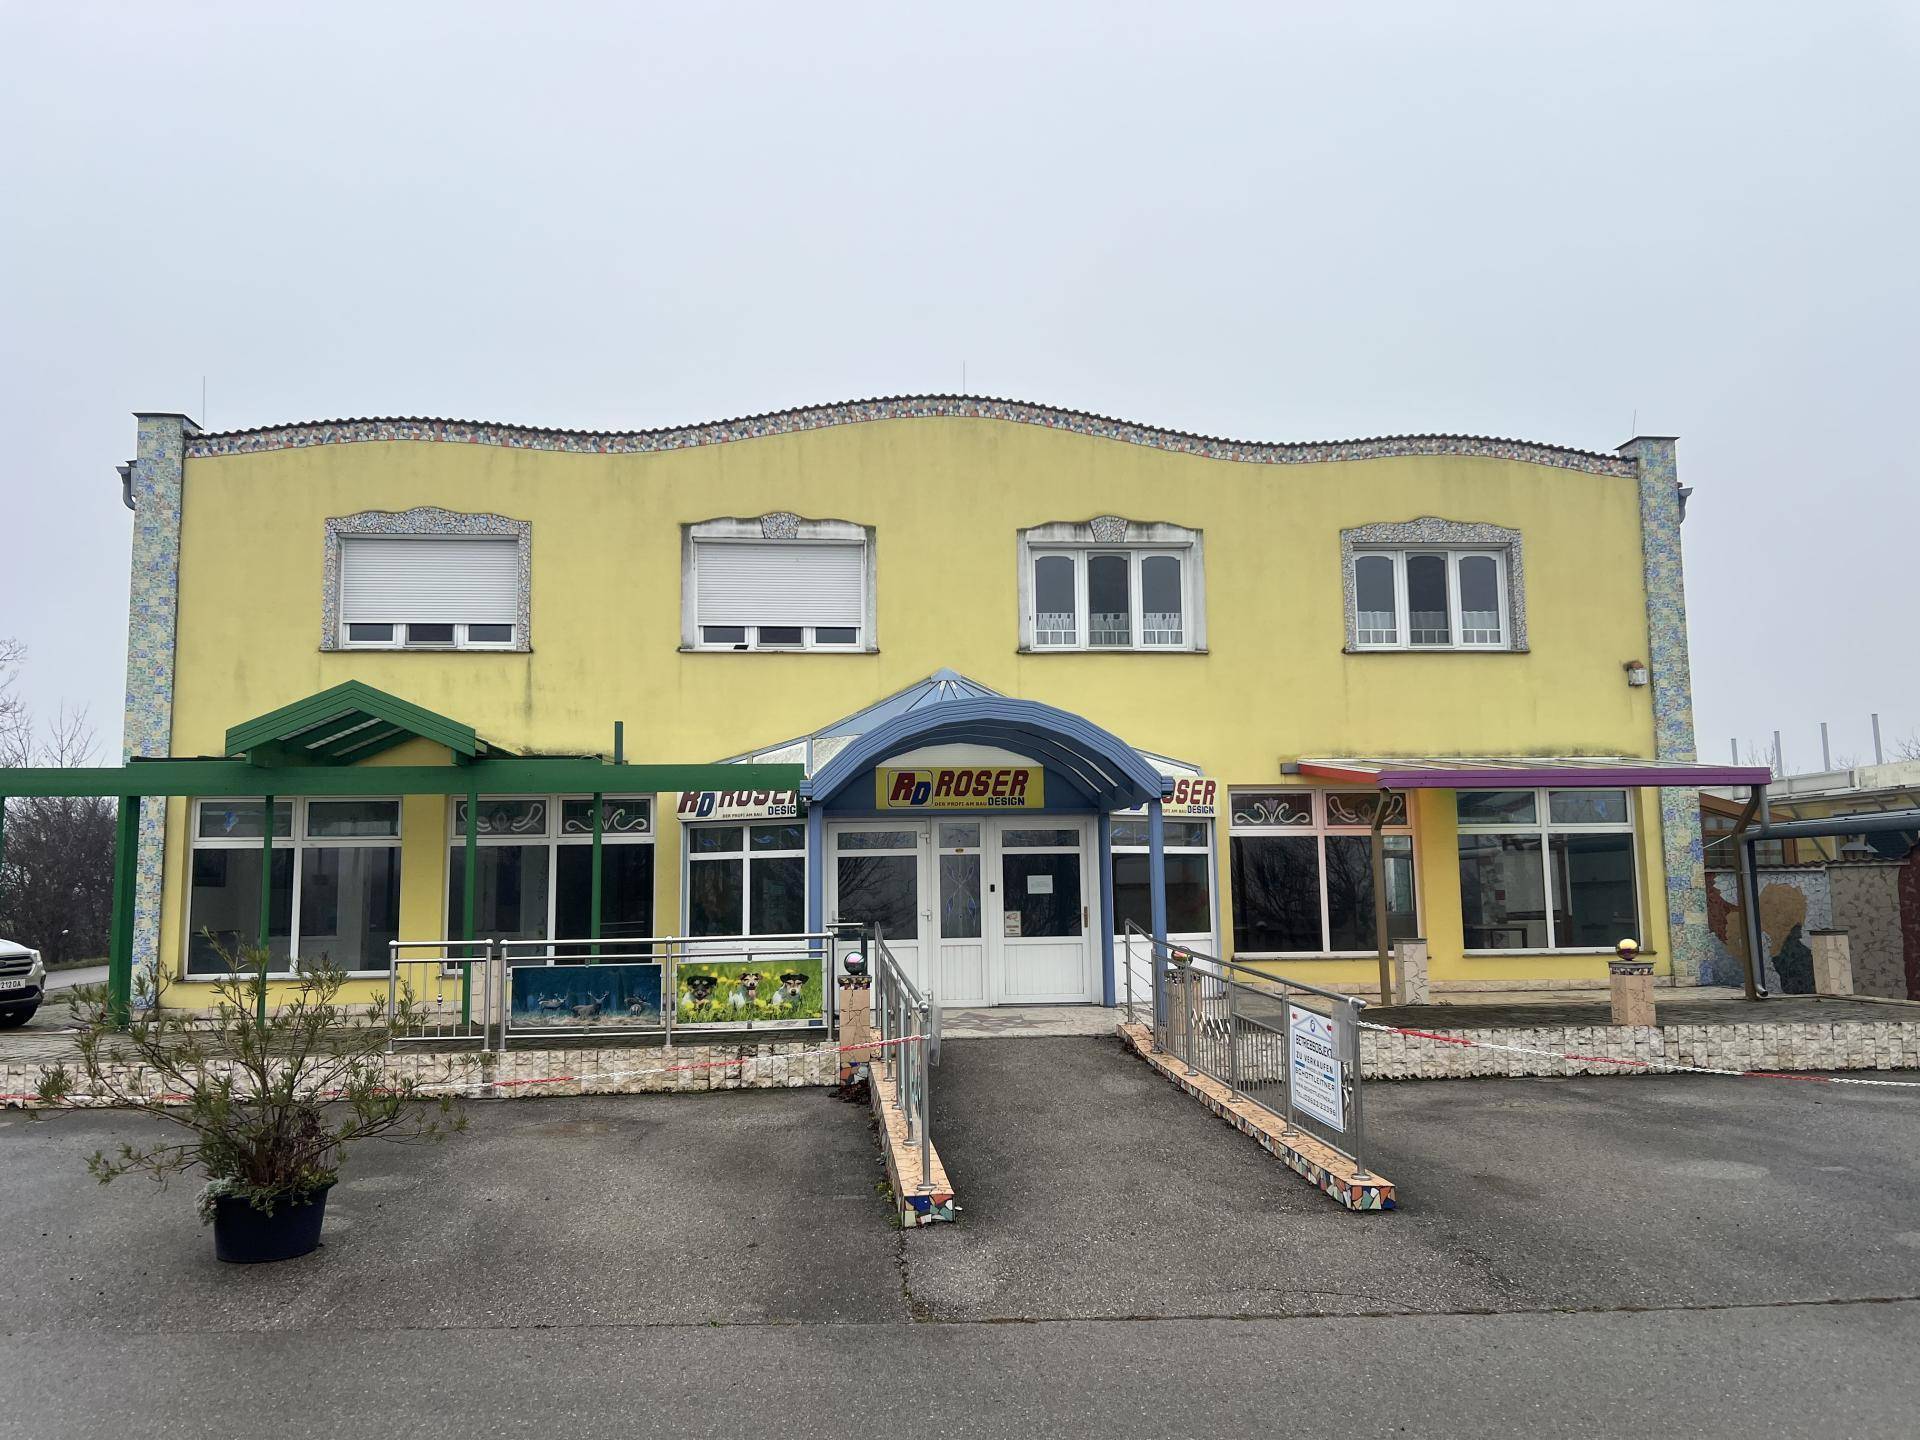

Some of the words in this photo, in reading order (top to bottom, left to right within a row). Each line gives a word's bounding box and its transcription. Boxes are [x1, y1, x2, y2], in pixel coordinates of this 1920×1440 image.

[889, 772, 931, 805] RD
[934, 770, 1030, 797] ROSER
[1162, 779, 1216, 805] SER
[988, 796, 1025, 806] DESIGN
[1187, 805, 1215, 814] DESIGN
[768, 805, 796, 816] DESIG
[1296, 1050, 1303, 1060] ZU
[1304, 1054, 1334, 1074] VERKAUFEN
